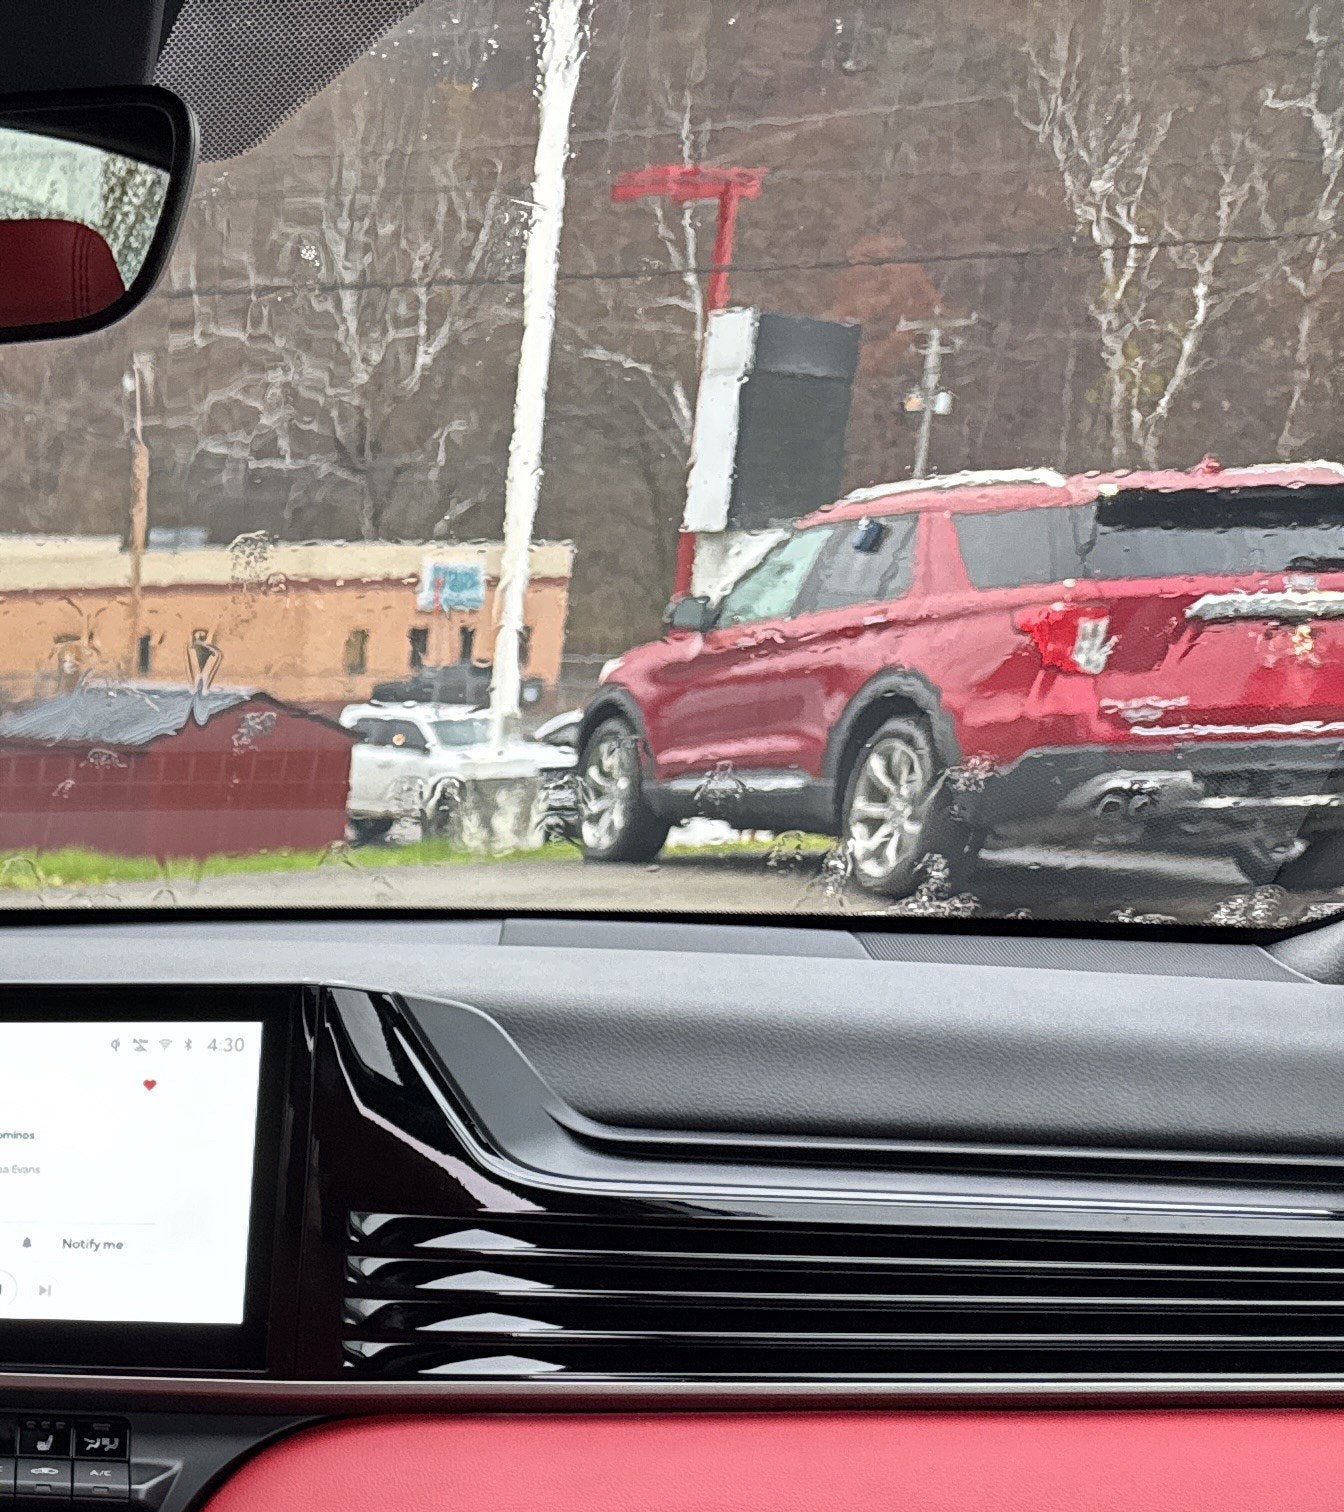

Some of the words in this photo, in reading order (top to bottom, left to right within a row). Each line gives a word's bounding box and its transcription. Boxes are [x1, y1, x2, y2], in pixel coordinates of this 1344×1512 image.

[207, 1037, 245, 1052] 4:30
[12, 1164, 41, 1174] Evans
[62, 1238, 100, 1252] Notify
[102, 1240, 124, 1250] me
[89, 1469, 112, 1477] A/C
